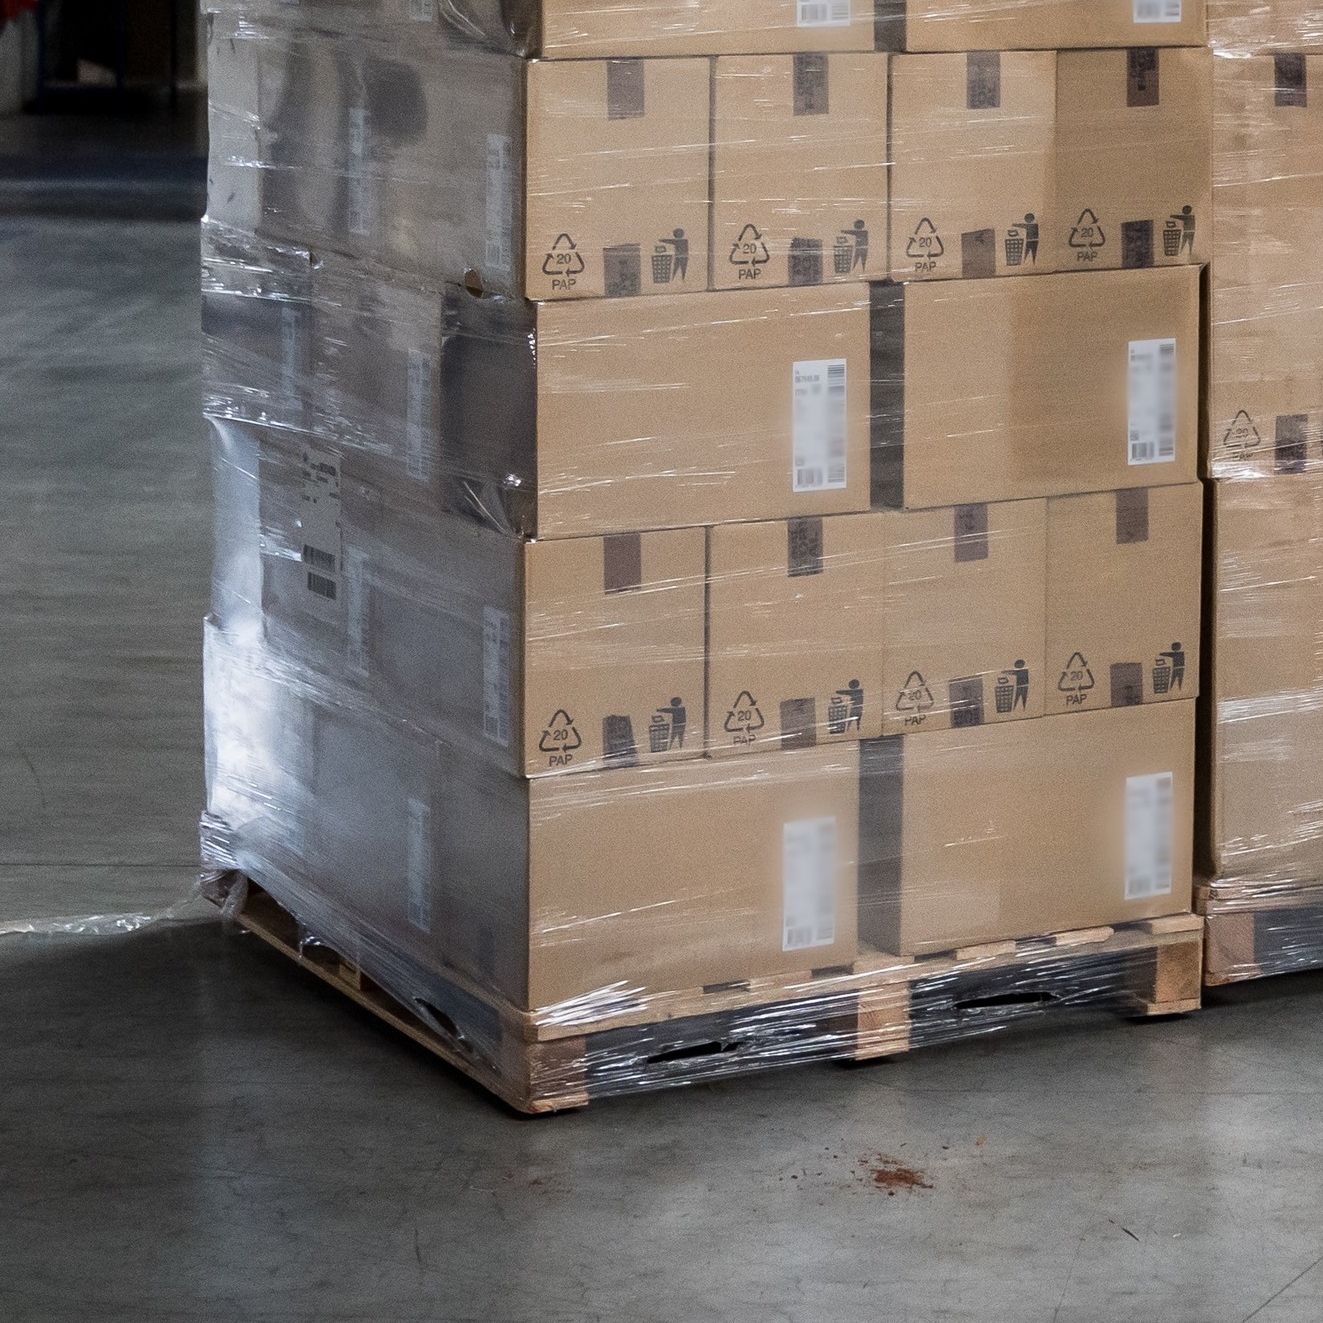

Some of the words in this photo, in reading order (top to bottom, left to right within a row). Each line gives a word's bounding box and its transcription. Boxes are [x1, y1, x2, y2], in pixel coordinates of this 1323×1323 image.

[1080, 227, 1094, 238] 20
[918, 237, 932, 248] 20
[742, 243, 757, 255] 20
[556, 254, 572, 265] 20
[1076, 251, 1098, 262] PAP
[914, 261, 937, 273] PAP
[738, 268, 762, 280] PAP
[552, 279, 577, 291] PAP
[1070, 670, 1084, 681] 20
[908, 690, 922, 701] 20
[1066, 694, 1087, 706] PAP
[737, 709, 752, 721] 20
[904, 714, 927, 726] PAP
[553, 729, 569, 741] 20
[733, 733, 756, 746] PAP
[549, 754, 573, 767] PAP
